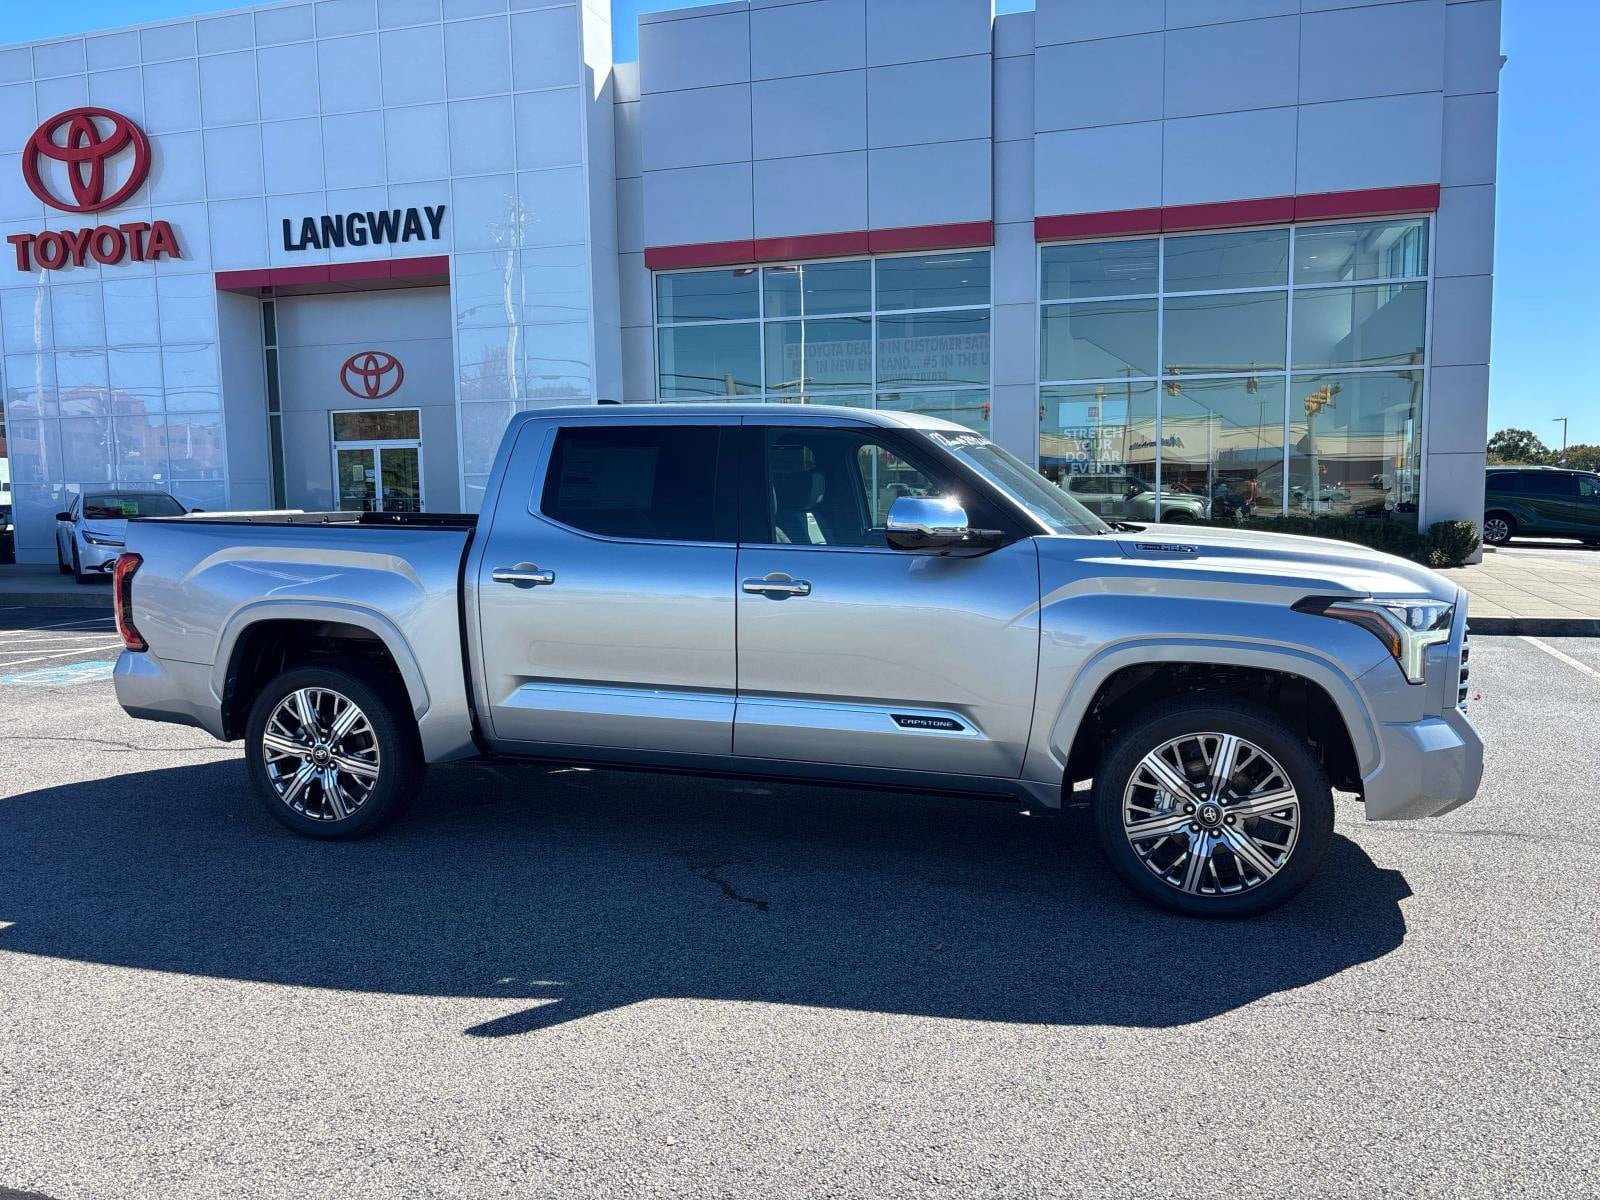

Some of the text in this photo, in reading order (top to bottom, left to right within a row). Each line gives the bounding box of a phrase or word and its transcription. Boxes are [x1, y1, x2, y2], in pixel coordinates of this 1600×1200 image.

[282, 205, 446, 251] LANGWAY
[7, 220, 181, 271] TOYOTA
[804, 341, 845, 360] TOYOTA
[846, 340, 886, 356] DEALR
[888, 340, 901, 354] IN
[903, 336, 962, 354] CUSTOMER
[816, 359, 828, 373] IN
[830, 357, 856, 373] NEW
[858, 355, 920, 371] ENLAND...
[941, 353, 954, 368] IN
[957, 352, 978, 367] THE
[1063, 427, 1123, 439] STRETCH
[1073, 439, 1113, 450] YOUR
[900, 718, 954, 728] CAPSTONE
